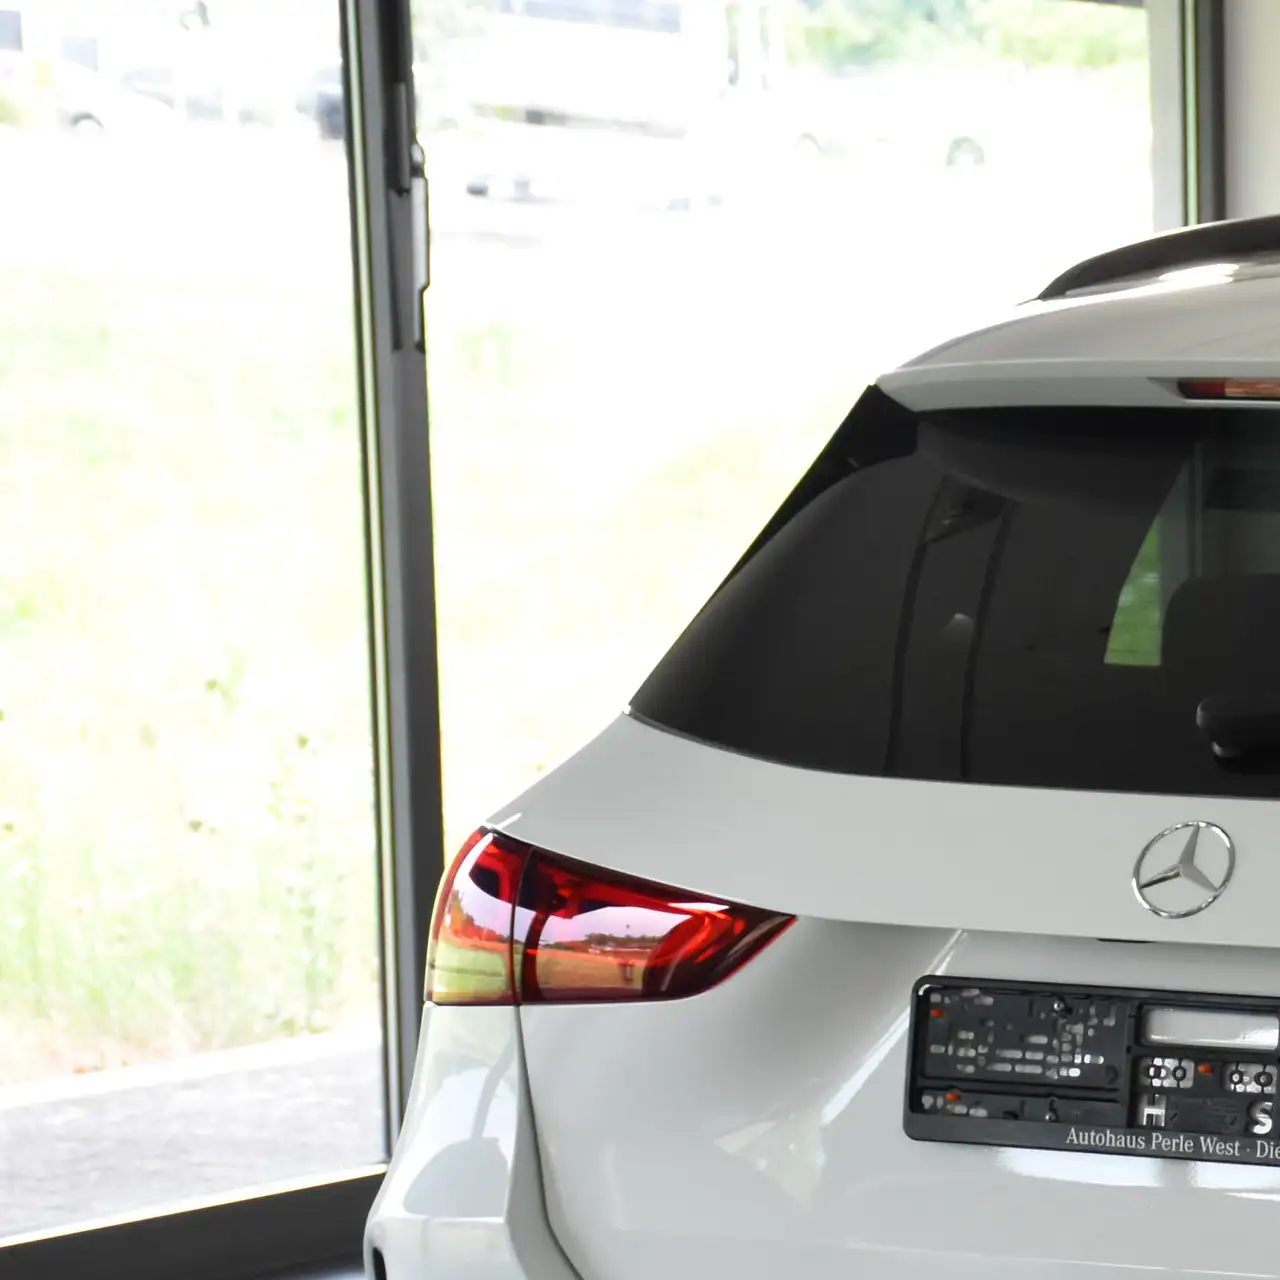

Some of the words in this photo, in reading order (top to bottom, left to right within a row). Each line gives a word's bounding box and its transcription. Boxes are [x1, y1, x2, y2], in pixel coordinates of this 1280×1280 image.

[1066, 1127, 1146, 1149] Autohaus
[1151, 1132, 1194, 1153] Perle
[1200, 1136, 1241, 1156] West
